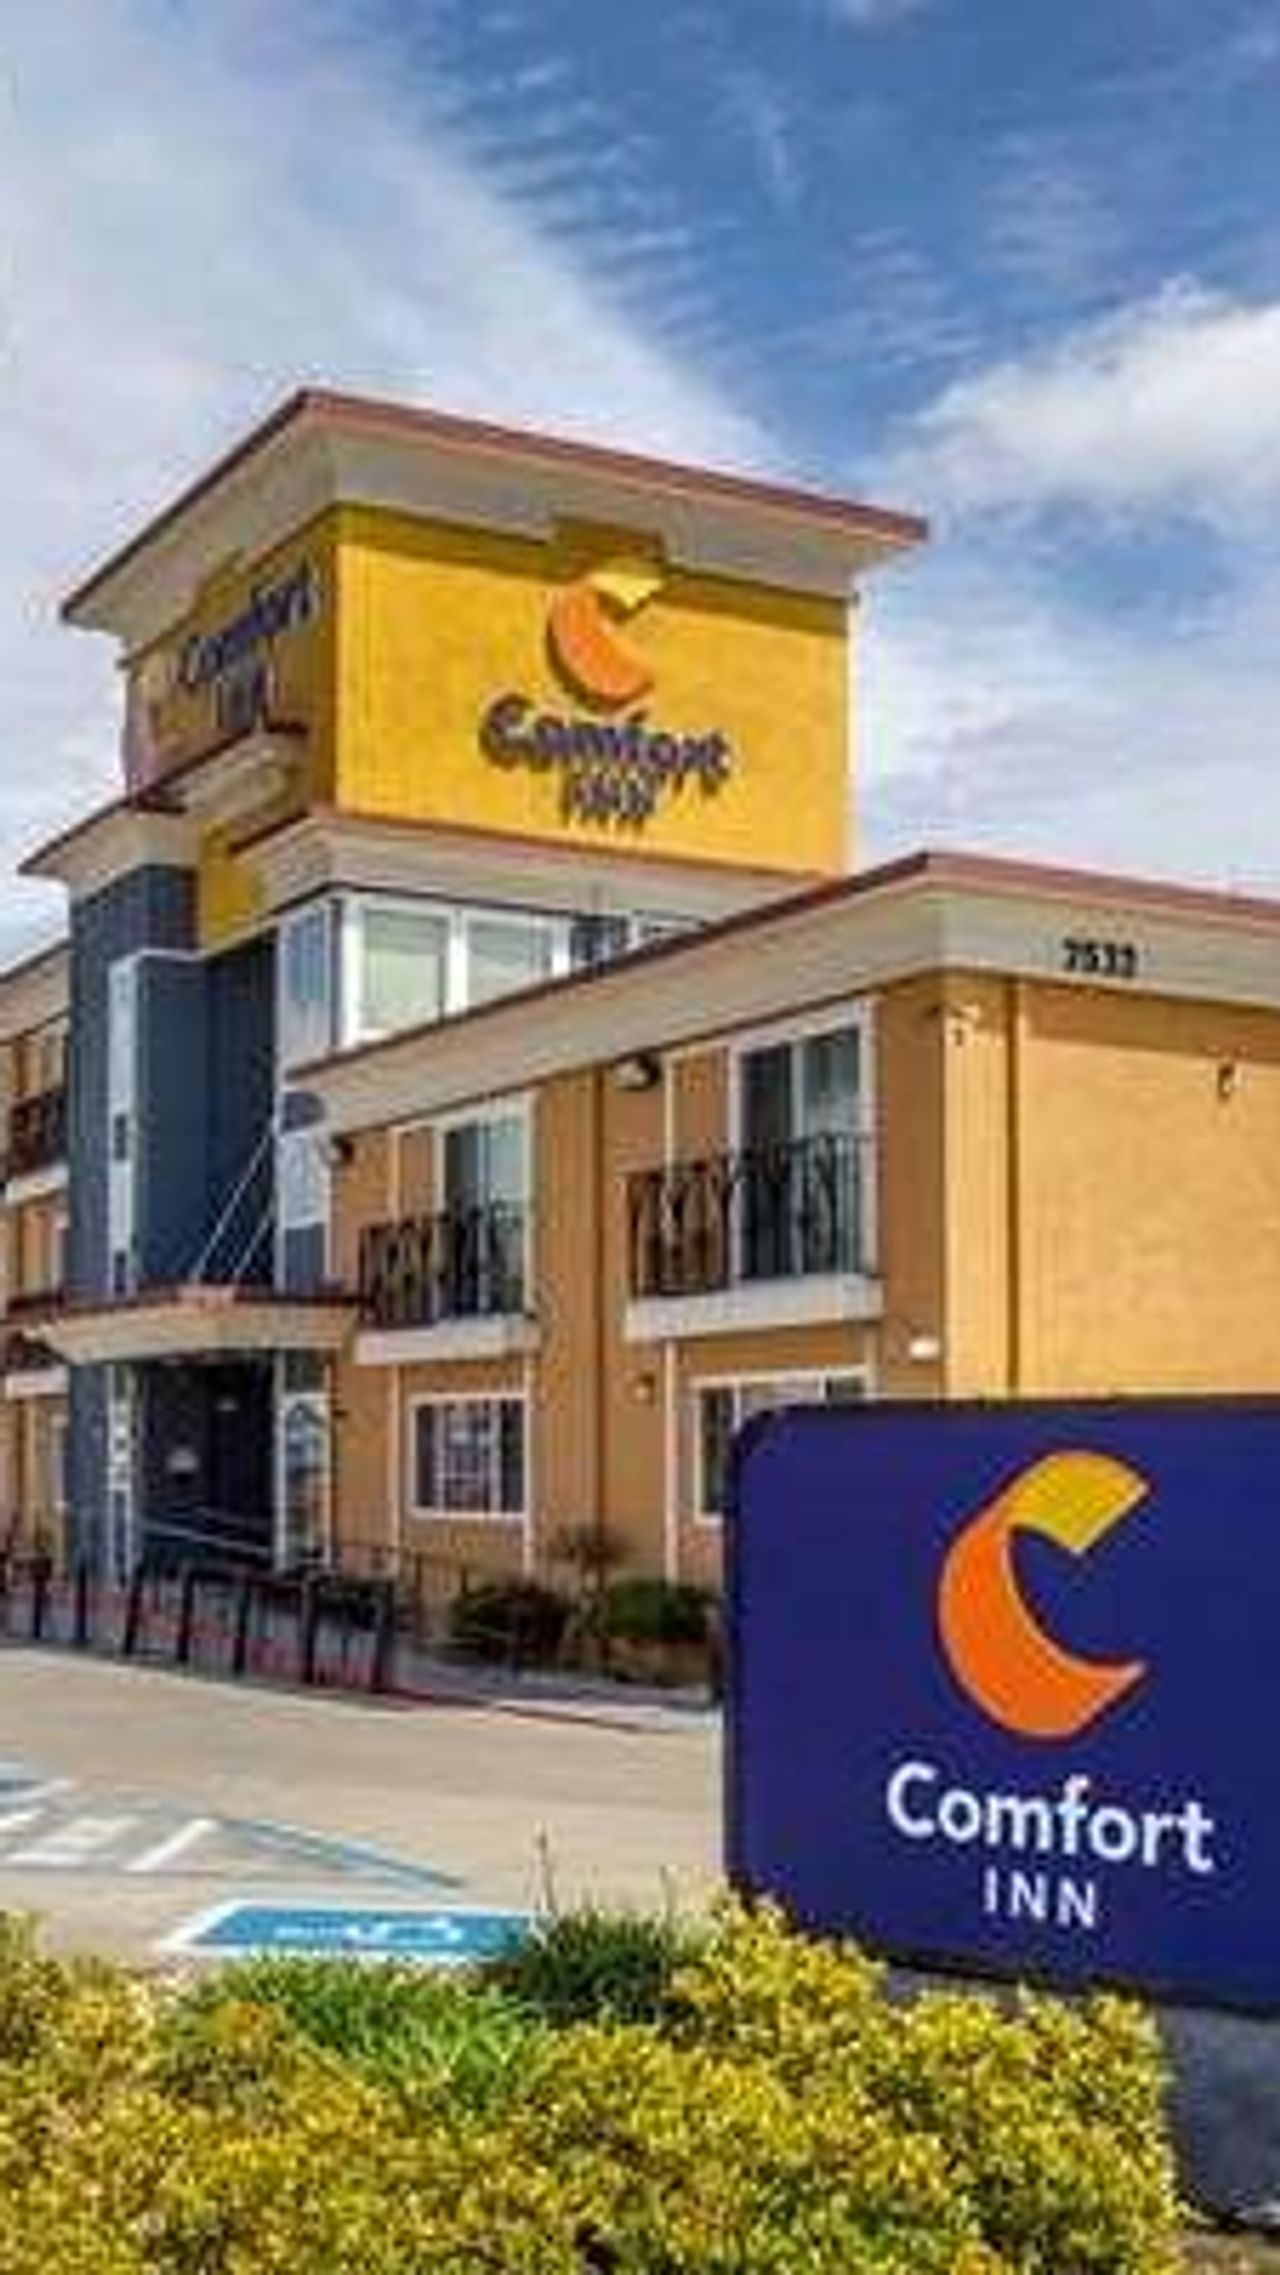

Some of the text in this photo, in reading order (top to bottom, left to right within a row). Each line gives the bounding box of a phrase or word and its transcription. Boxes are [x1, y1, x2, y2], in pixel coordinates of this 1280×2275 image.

[481, 693, 730, 792] Comfort
[886, 1760, 1214, 1873] Comfort
[984, 1866, 1096, 1930] INN
